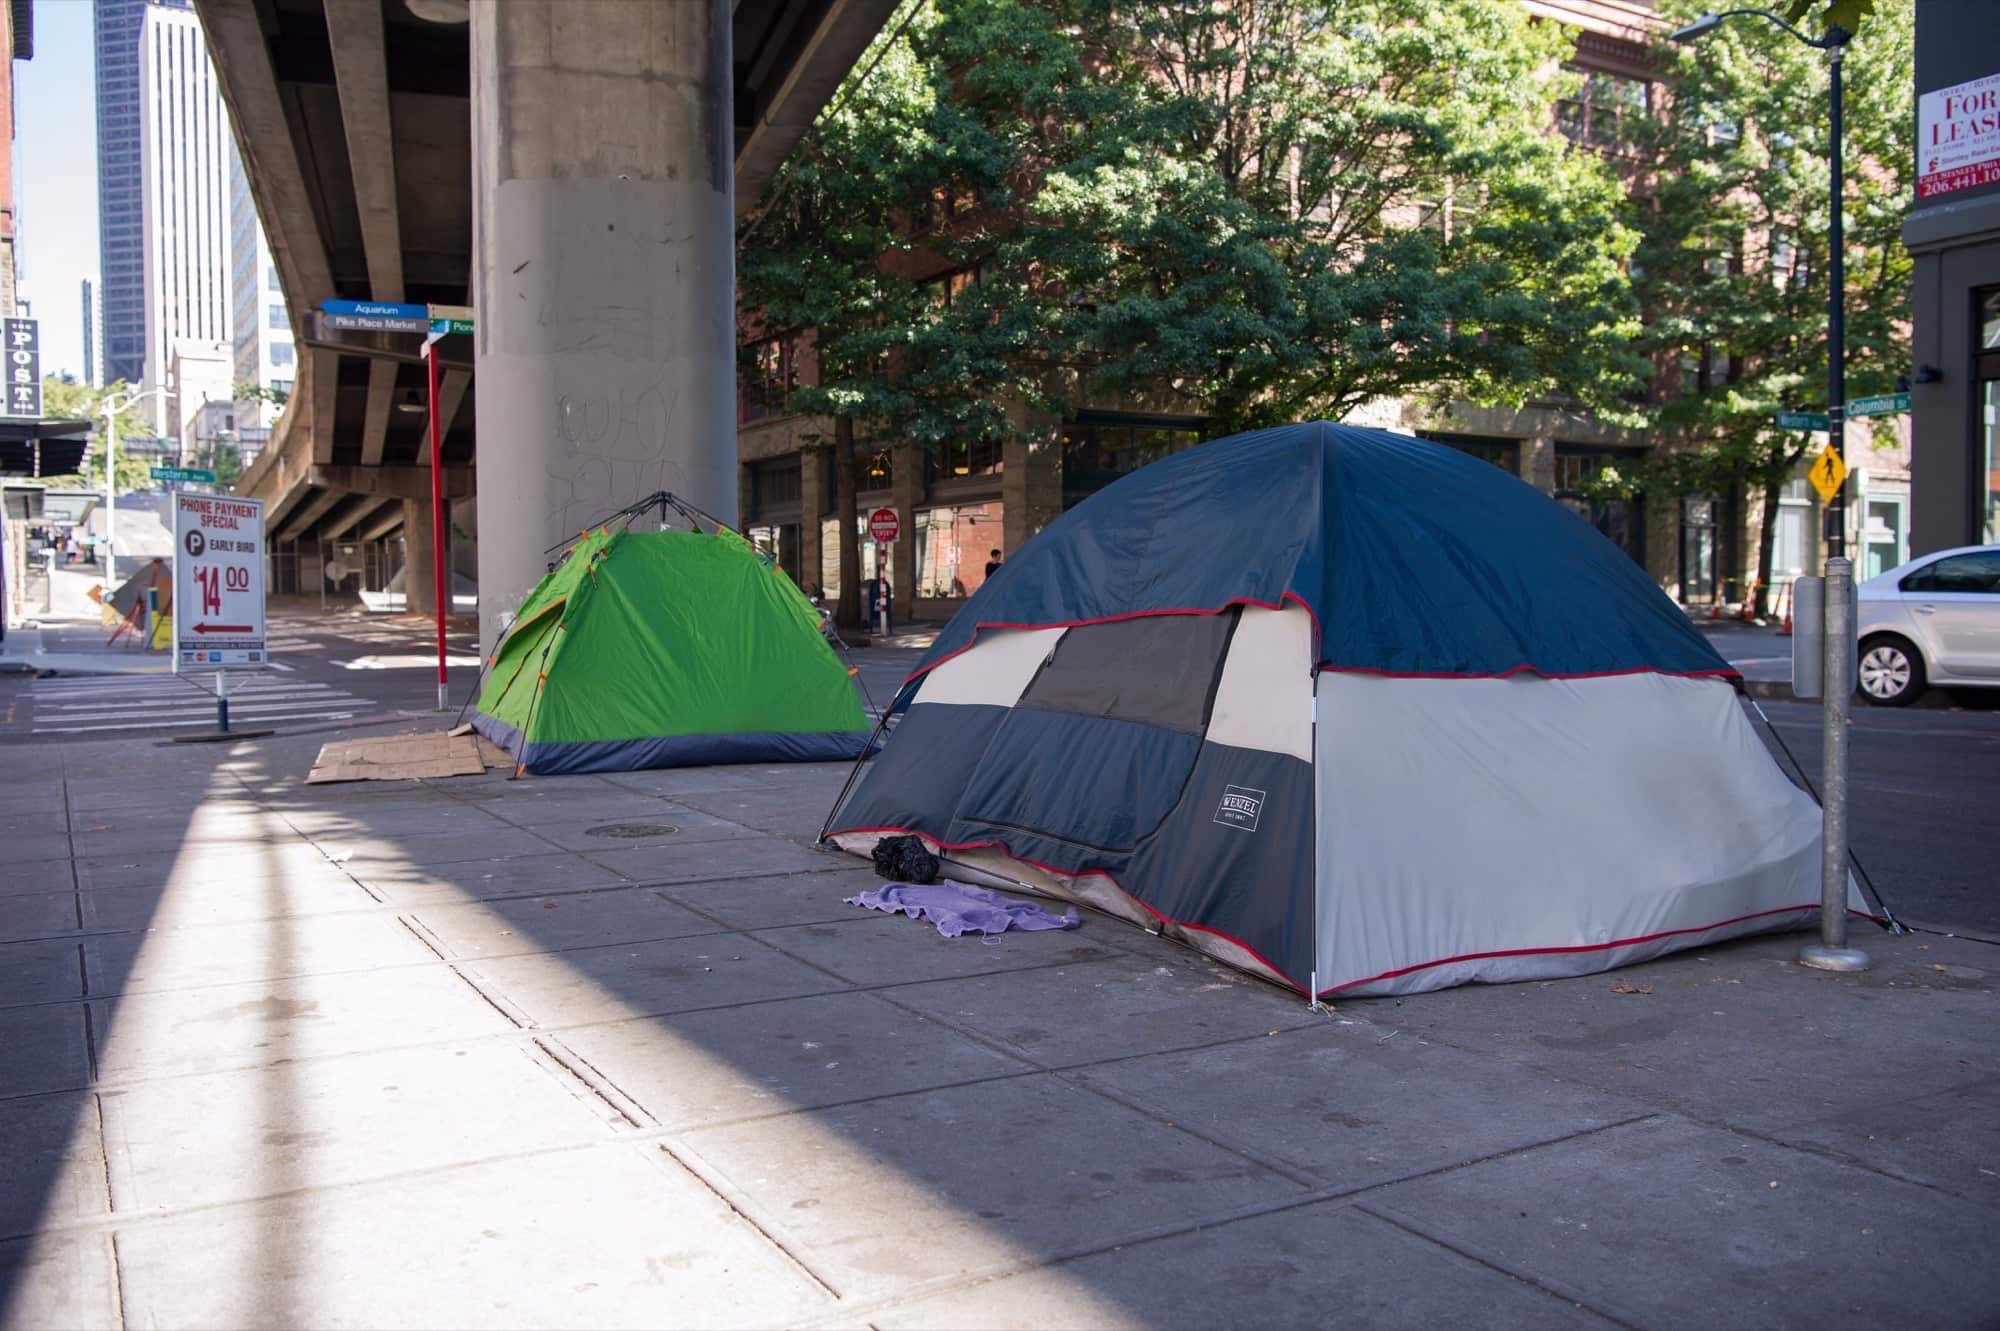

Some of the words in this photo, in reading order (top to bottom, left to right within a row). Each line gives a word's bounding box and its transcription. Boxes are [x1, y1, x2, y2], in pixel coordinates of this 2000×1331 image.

[1946, 89, 1996, 119] FOR
[355, 304, 399, 315] Aquarium
[335, 317, 355, 327] Pike
[358, 318, 382, 328] Place
[385, 320, 417, 330] Market
[12, 331, 32, 401] POST
[1848, 399, 1895, 415] Columbia
[152, 469, 188, 480] Western
[180, 498, 212, 514] PHONE
[214, 502, 258, 519] PAYMENT
[200, 515, 240, 530] SPECIAL
[209, 539, 234, 552] EARLY
[236, 542, 256, 553] BIRD
[1223, 797, 1256, 813] WENZEL
